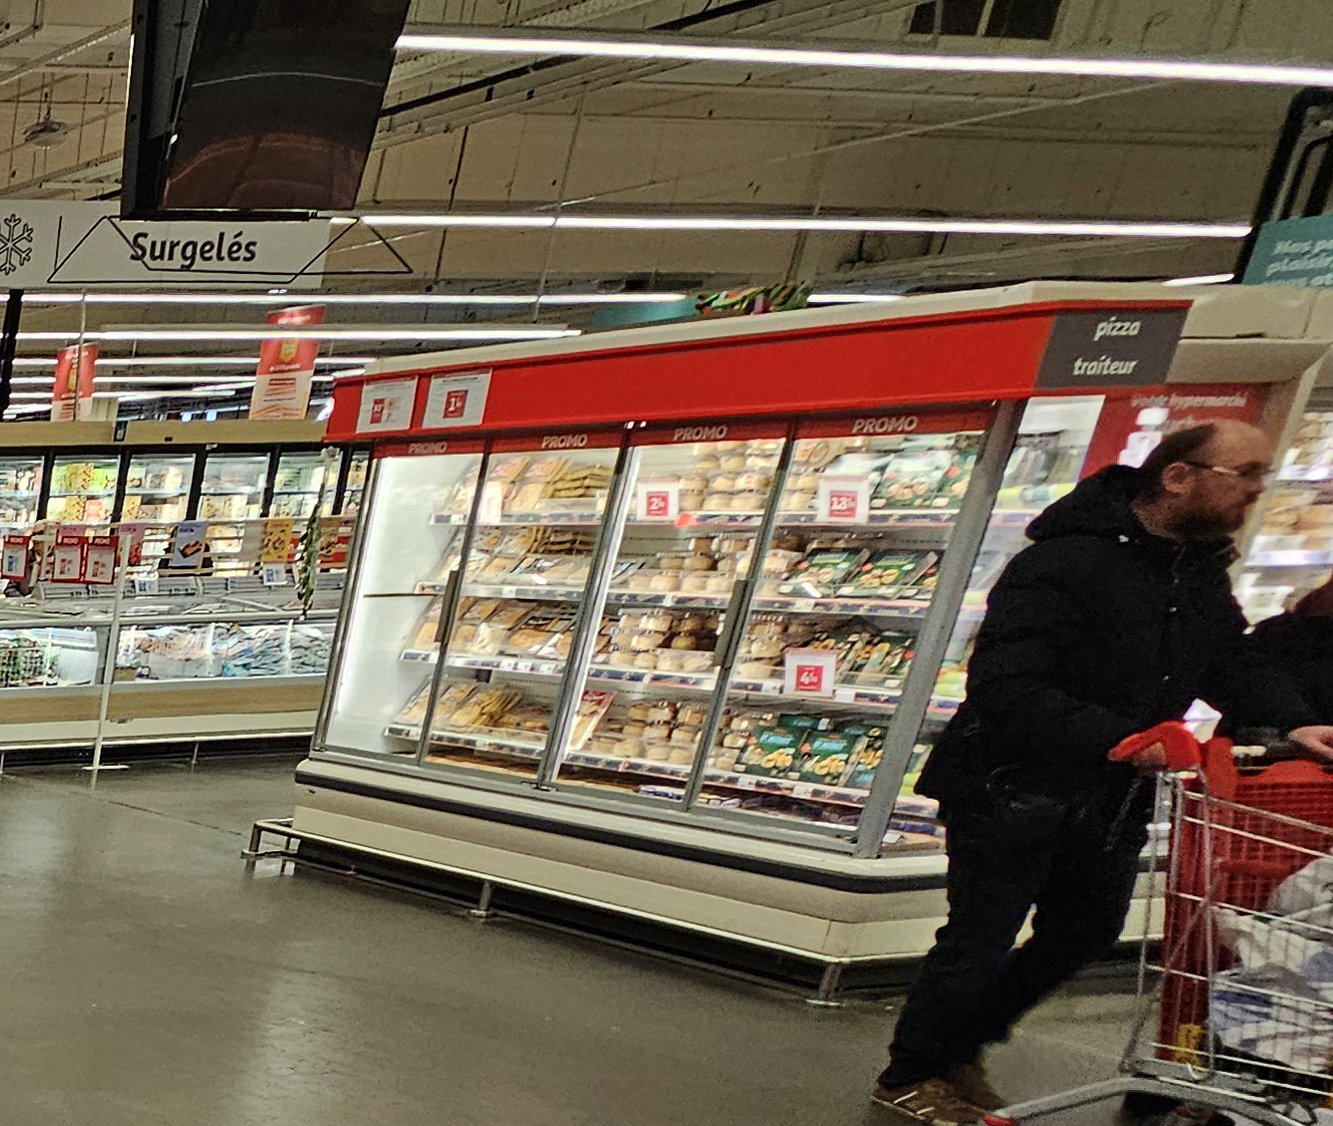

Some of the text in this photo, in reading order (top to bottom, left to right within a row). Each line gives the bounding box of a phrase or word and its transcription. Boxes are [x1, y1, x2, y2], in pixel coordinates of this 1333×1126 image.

[129, 229, 258, 269] Surgelés
[1092, 316, 1142, 342] pizza
[1073, 355, 1138, 376] traiteur
[672, 425, 729, 442] PROMO
[851, 415, 919, 434] PROMO
[408, 441, 448, 454] PROMO
[540, 434, 589, 449] PROMO
